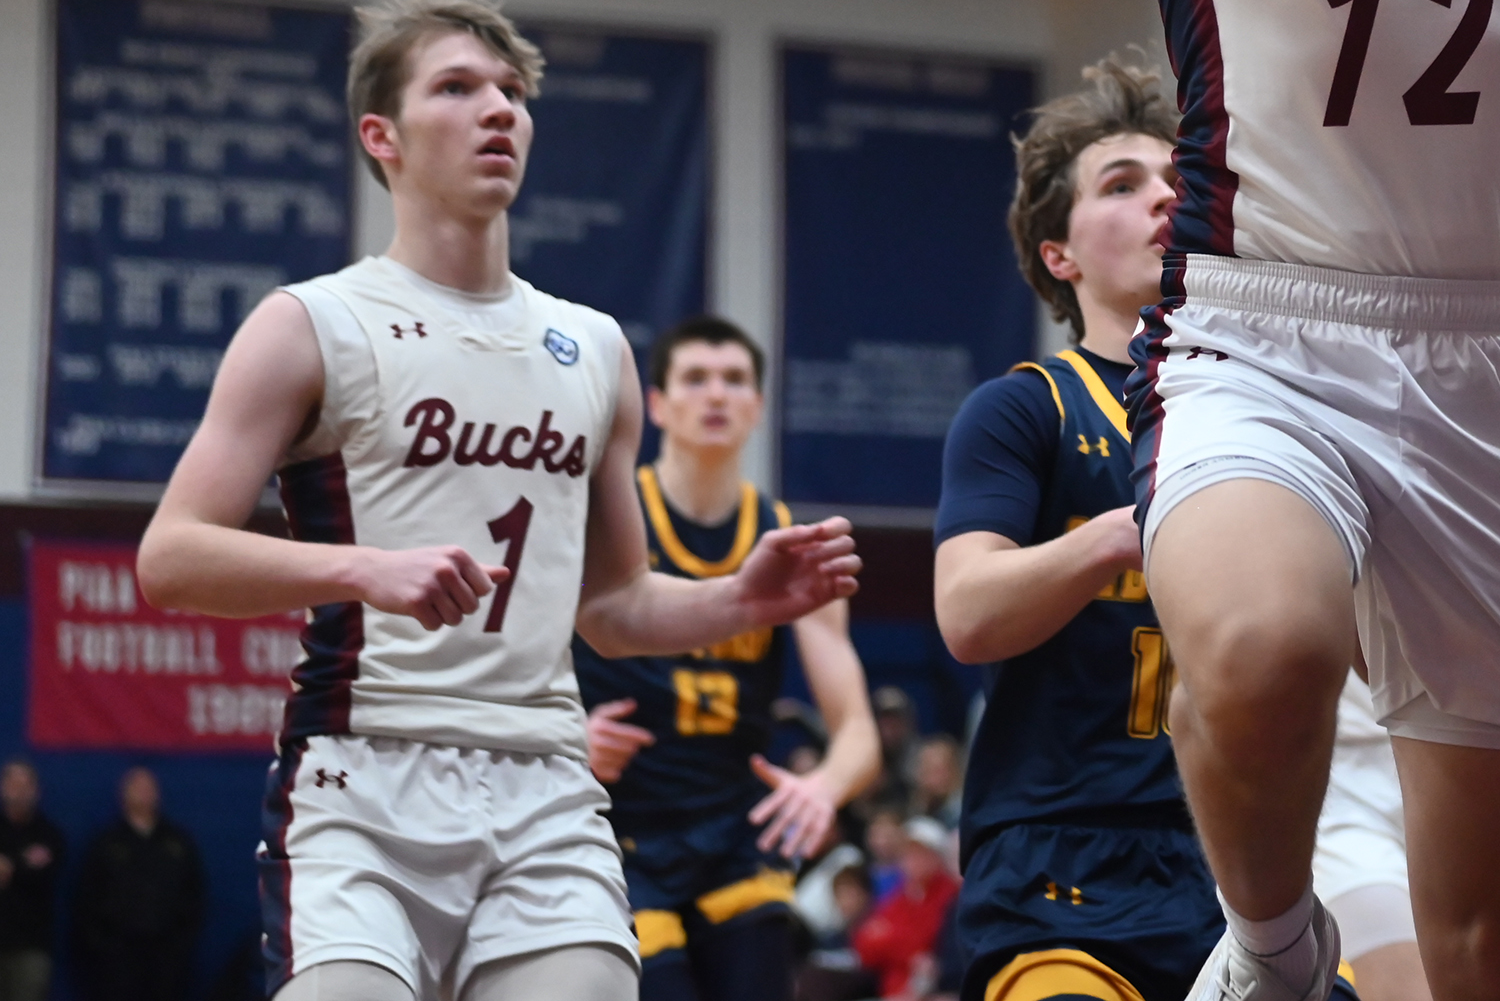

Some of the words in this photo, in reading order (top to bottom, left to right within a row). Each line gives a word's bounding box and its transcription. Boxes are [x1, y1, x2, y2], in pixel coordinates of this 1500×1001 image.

[402, 397, 587, 478] Bucks
[483, 494, 534, 633] 1
[57, 619, 223, 676] FOOTBALL
[1126, 626, 1173, 739] 1
[671, 667, 740, 737] 13
